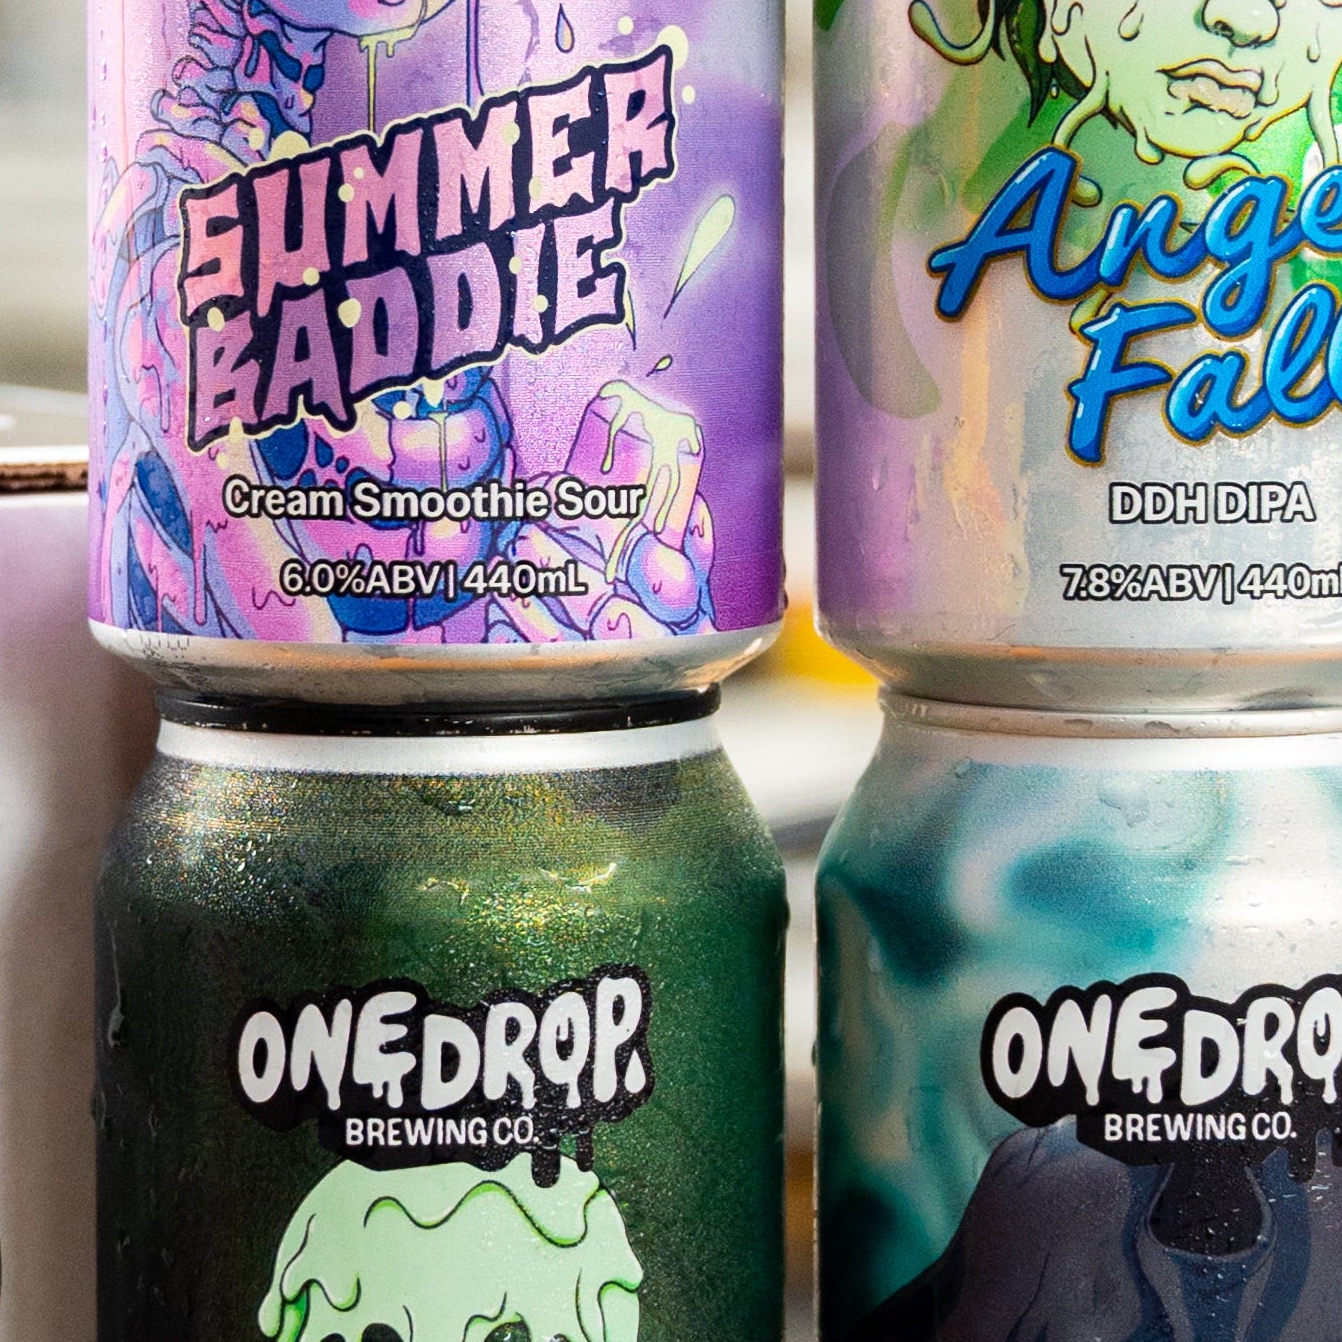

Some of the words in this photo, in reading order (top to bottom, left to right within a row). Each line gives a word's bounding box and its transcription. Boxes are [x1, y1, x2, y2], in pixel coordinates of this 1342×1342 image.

[183, 49, 674, 317] SUMMER
[190, 202, 625, 446] BADDIE
[224, 476, 344, 517] Cream
[354, 480, 549, 519] Smoothie
[557, 477, 644, 517] Sour
[1110, 483, 1208, 523] DDH
[1215, 482, 1316, 522] DIPA
[345, 1117, 487, 1147] BREWING
[492, 1119, 540, 1145] CO.
[1104, 1112, 1245, 1141] BREWING
[1250, 1111, 1296, 1139] CO.
